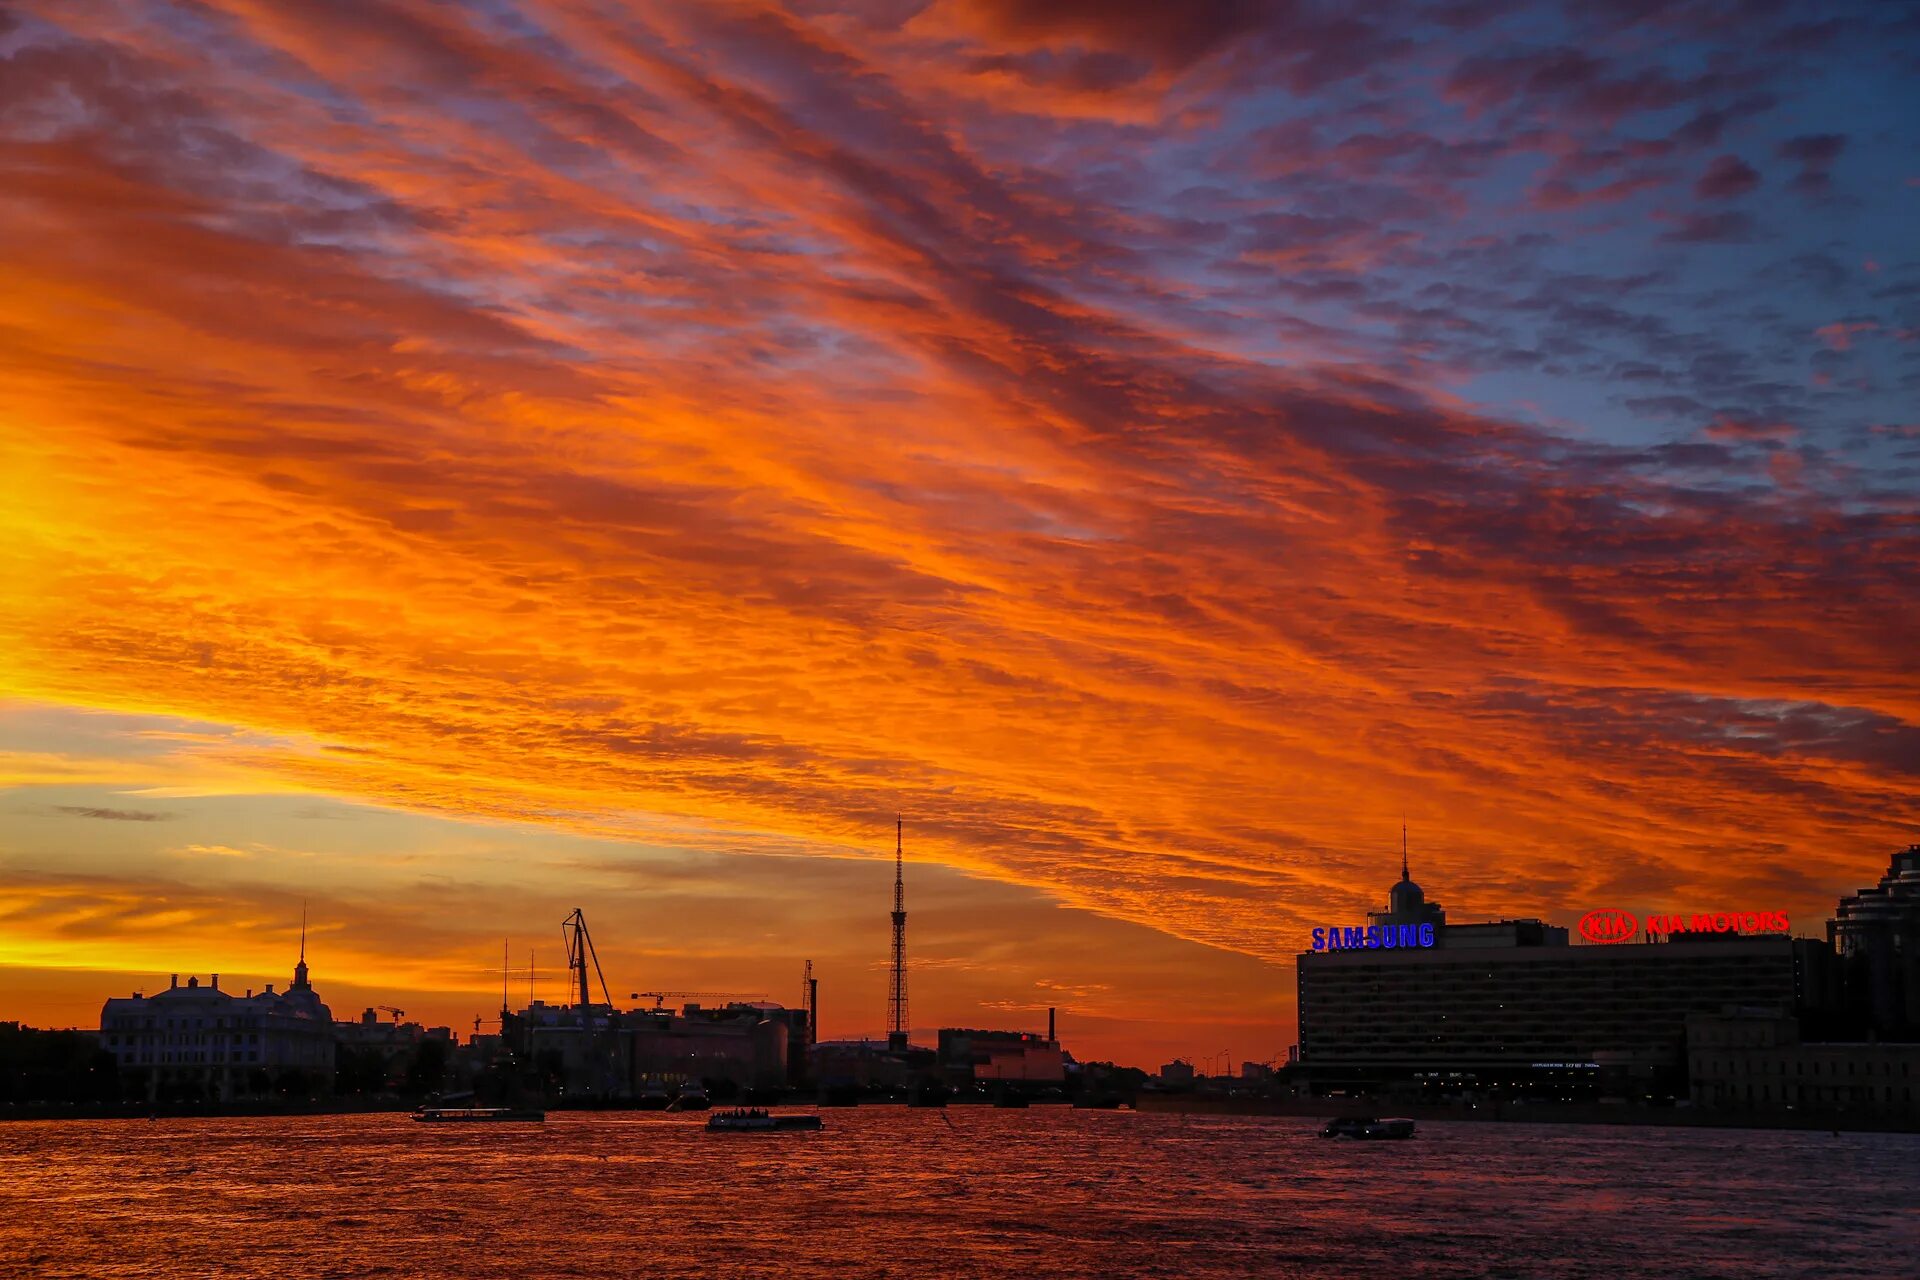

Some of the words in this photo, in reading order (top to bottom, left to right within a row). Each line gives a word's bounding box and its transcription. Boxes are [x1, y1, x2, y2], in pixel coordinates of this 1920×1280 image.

[1588, 916, 1628, 935] KIA
[1646, 914, 1685, 934] KIA
[1690, 910, 1790, 933] MOTORS
[1312, 923, 1434, 950] SAMSUNG
